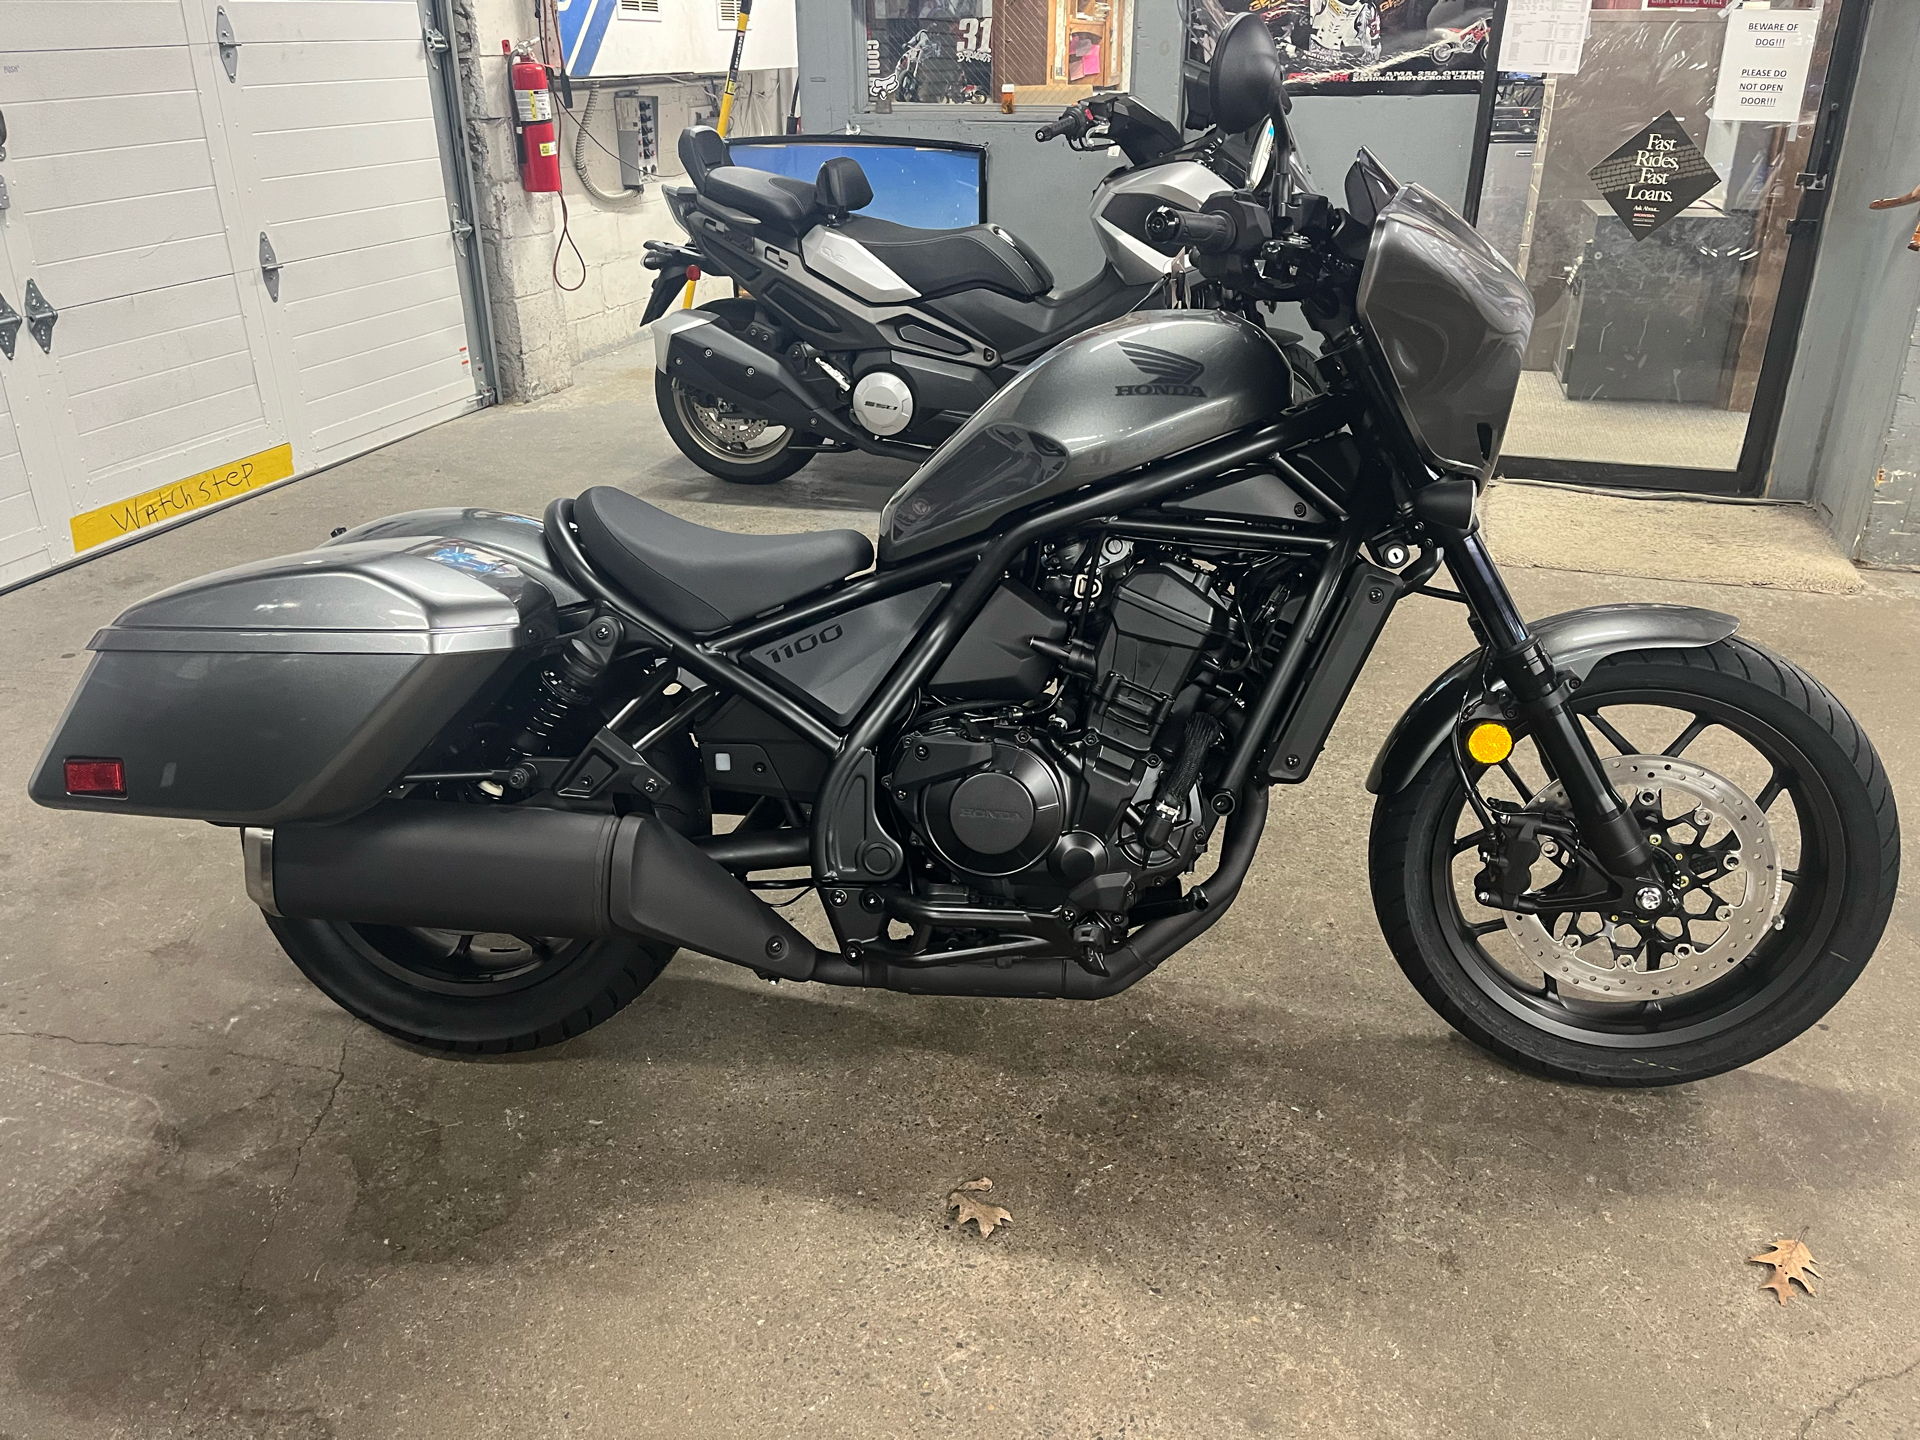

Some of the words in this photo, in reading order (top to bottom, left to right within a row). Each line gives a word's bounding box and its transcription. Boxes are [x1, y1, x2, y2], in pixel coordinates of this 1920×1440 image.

[1748, 22, 1784, 31] BEWARE
[1786, 23, 1799, 31] OF
[957, 18, 992, 53] 31
[1755, 38, 1785, 47] DOG!!!
[1741, 69, 1772, 77] PLEASE
[1773, 70, 1787, 78] DO
[1739, 83, 1758, 91] NOT
[1760, 84, 1784, 92] OPEN
[1741, 97, 1776, 105] DOOR!!!
[1646, 133, 1677, 151] Fast
[1634, 150, 1680, 171] Rides,
[1638, 167, 1670, 185] Fast
[1626, 183, 1673, 202] Loans.
[1115, 385, 1208, 398] HONDA
[765, 623, 844, 664] 1100
[960, 807, 1025, 821] HONDA
